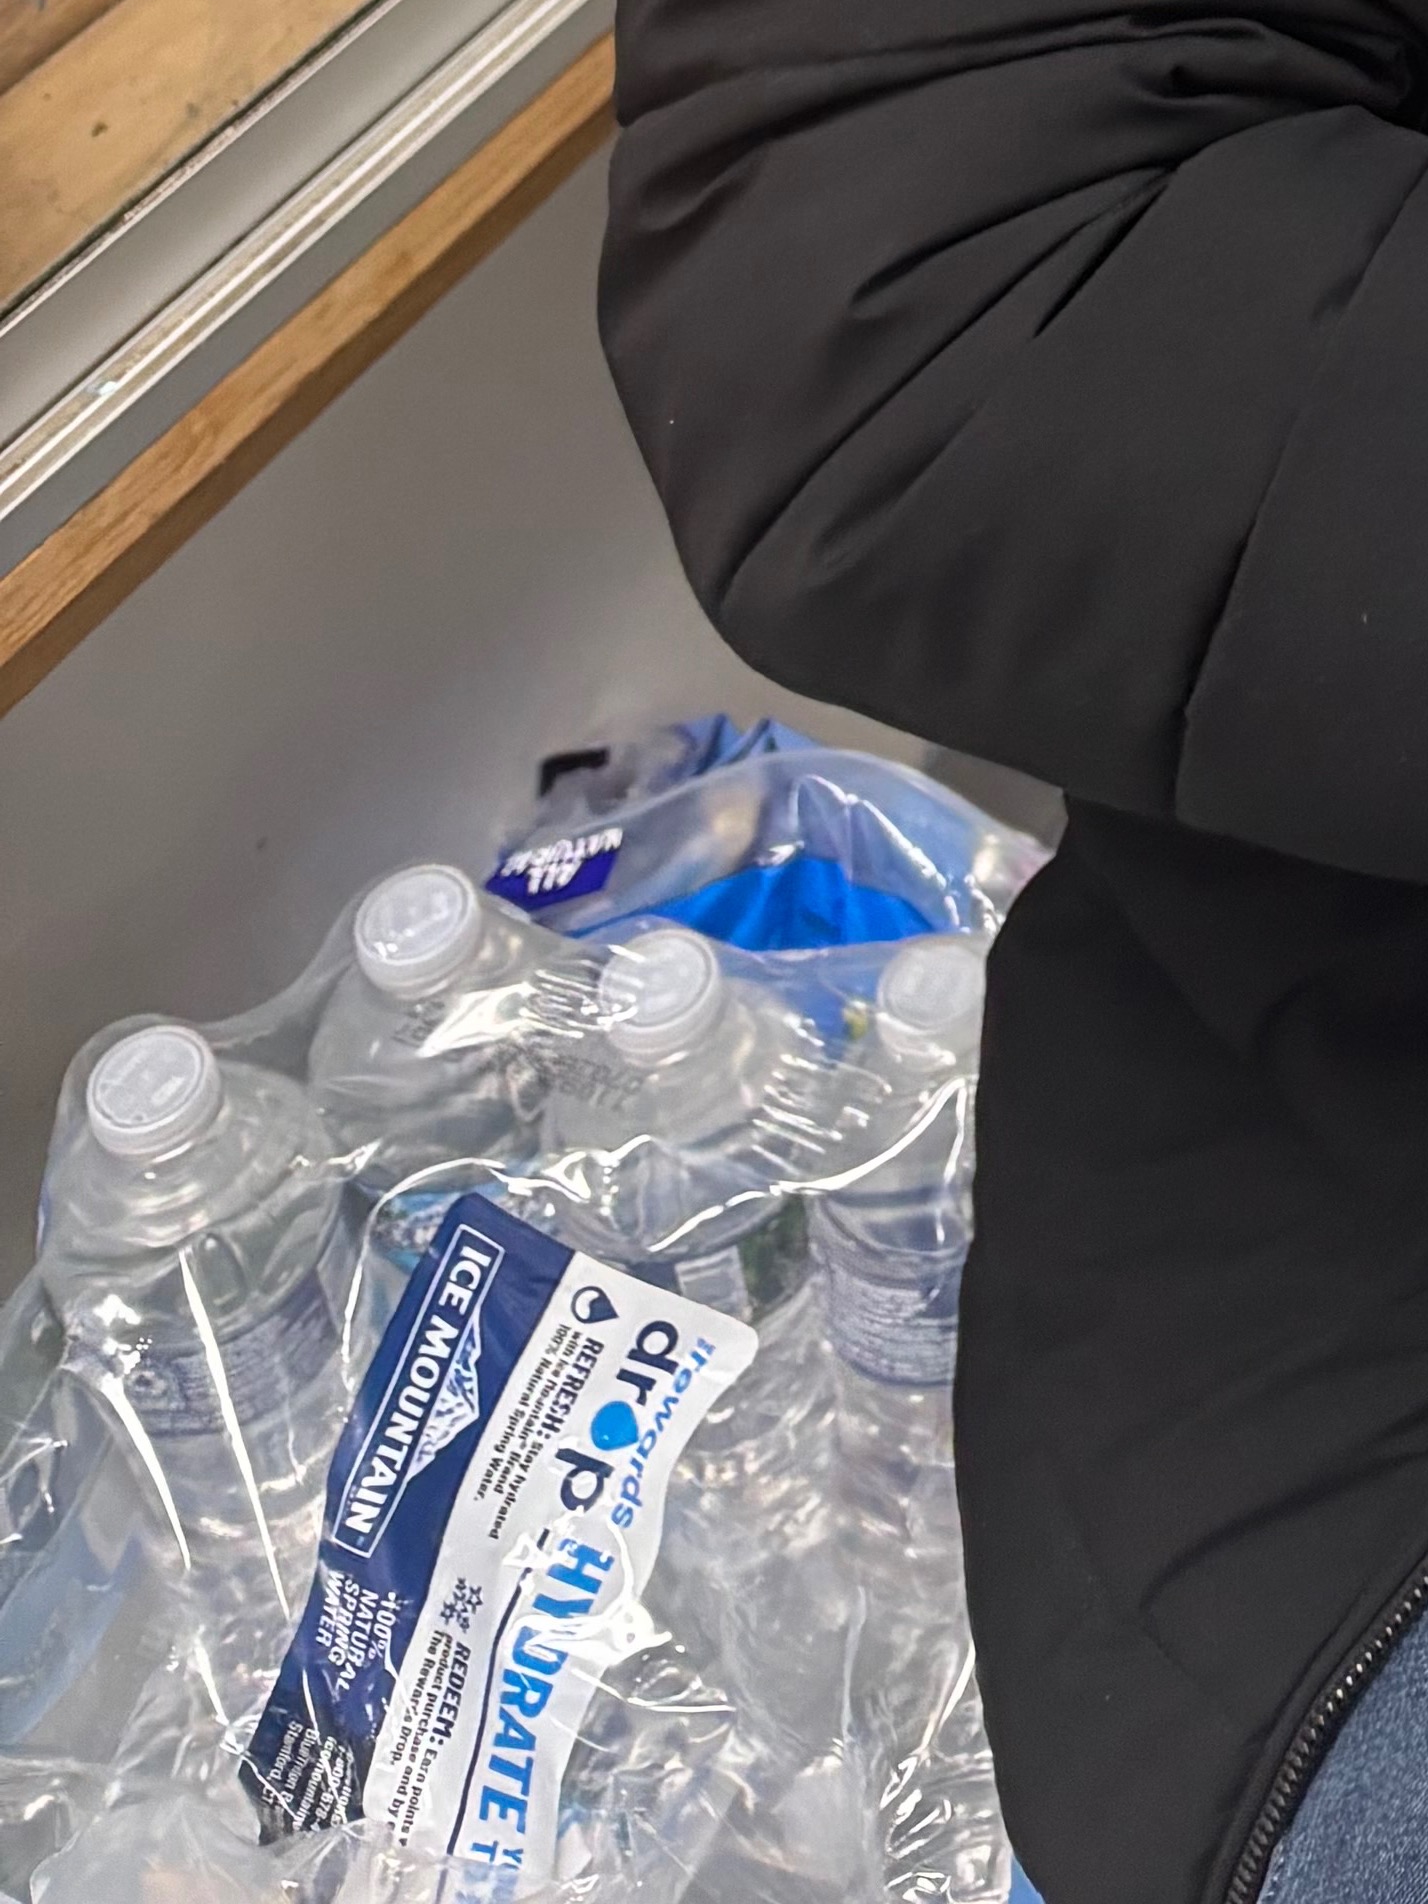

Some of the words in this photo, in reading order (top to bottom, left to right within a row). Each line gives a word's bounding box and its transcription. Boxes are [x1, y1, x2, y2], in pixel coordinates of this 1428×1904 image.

[438, 1242, 492, 1313] ICE
[544, 1323, 571, 1356] 100%
[561, 1329, 581, 1357] with
[517, 1357, 554, 1407] Natural
[535, 1337, 605, 1440] REFRESH:
[550, 1358, 569, 1377] Ice
[342, 1311, 459, 1534] MOUNTAIN
[493, 1407, 526, 1454] Spring
[473, 1455, 504, 1503] Water.
[492, 1450, 521, 1494] Brand
[517, 1440, 543, 1473] Stay
[487, 1473, 527, 1540] hydrated
[314, 1570, 345, 1647] WATER
[326, 1578, 361, 1666] SPRING
[335, 1588, 378, 1693] NATURAL
[427, 1629, 444, 1655] The
[430, 1632, 455, 1690] product
[429, 1641, 472, 1747] REDEEM:
[479, 1539, 614, 1834] HYDRATE
[388, 1725, 412, 1766] Drop.
[406, 1691, 437, 1763] purchase
[395, 1765, 414, 1796] and
[414, 1747, 437, 1783] Earn
[387, 1797, 404, 1818] by
[399, 1786, 423, 1834] points
